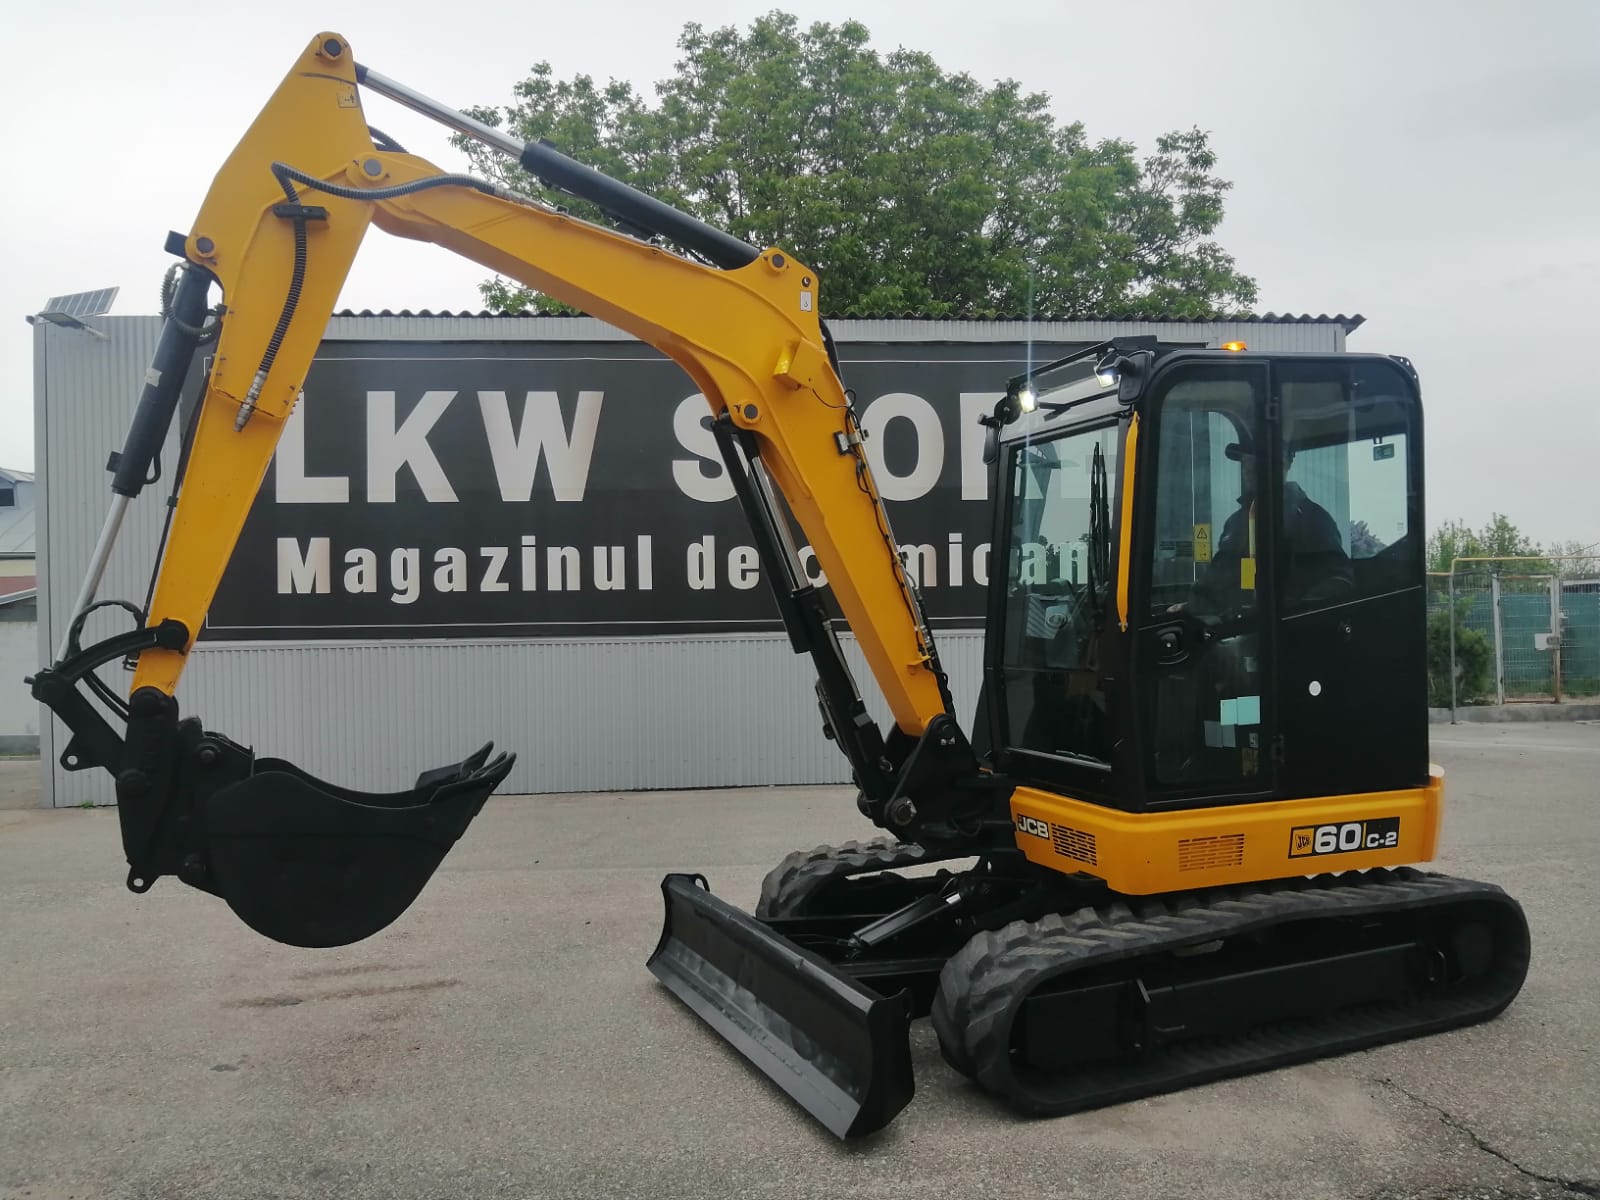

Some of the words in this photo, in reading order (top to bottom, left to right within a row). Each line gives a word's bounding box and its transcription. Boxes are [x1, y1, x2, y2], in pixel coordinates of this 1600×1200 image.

[276, 391, 604, 503] LKW
[672, 391, 1117, 503] SORE
[276, 535, 653, 604] Magazinul
[686, 535, 760, 590] de
[1017, 815, 1049, 836] JCB
[1314, 822, 1362, 853] 60
